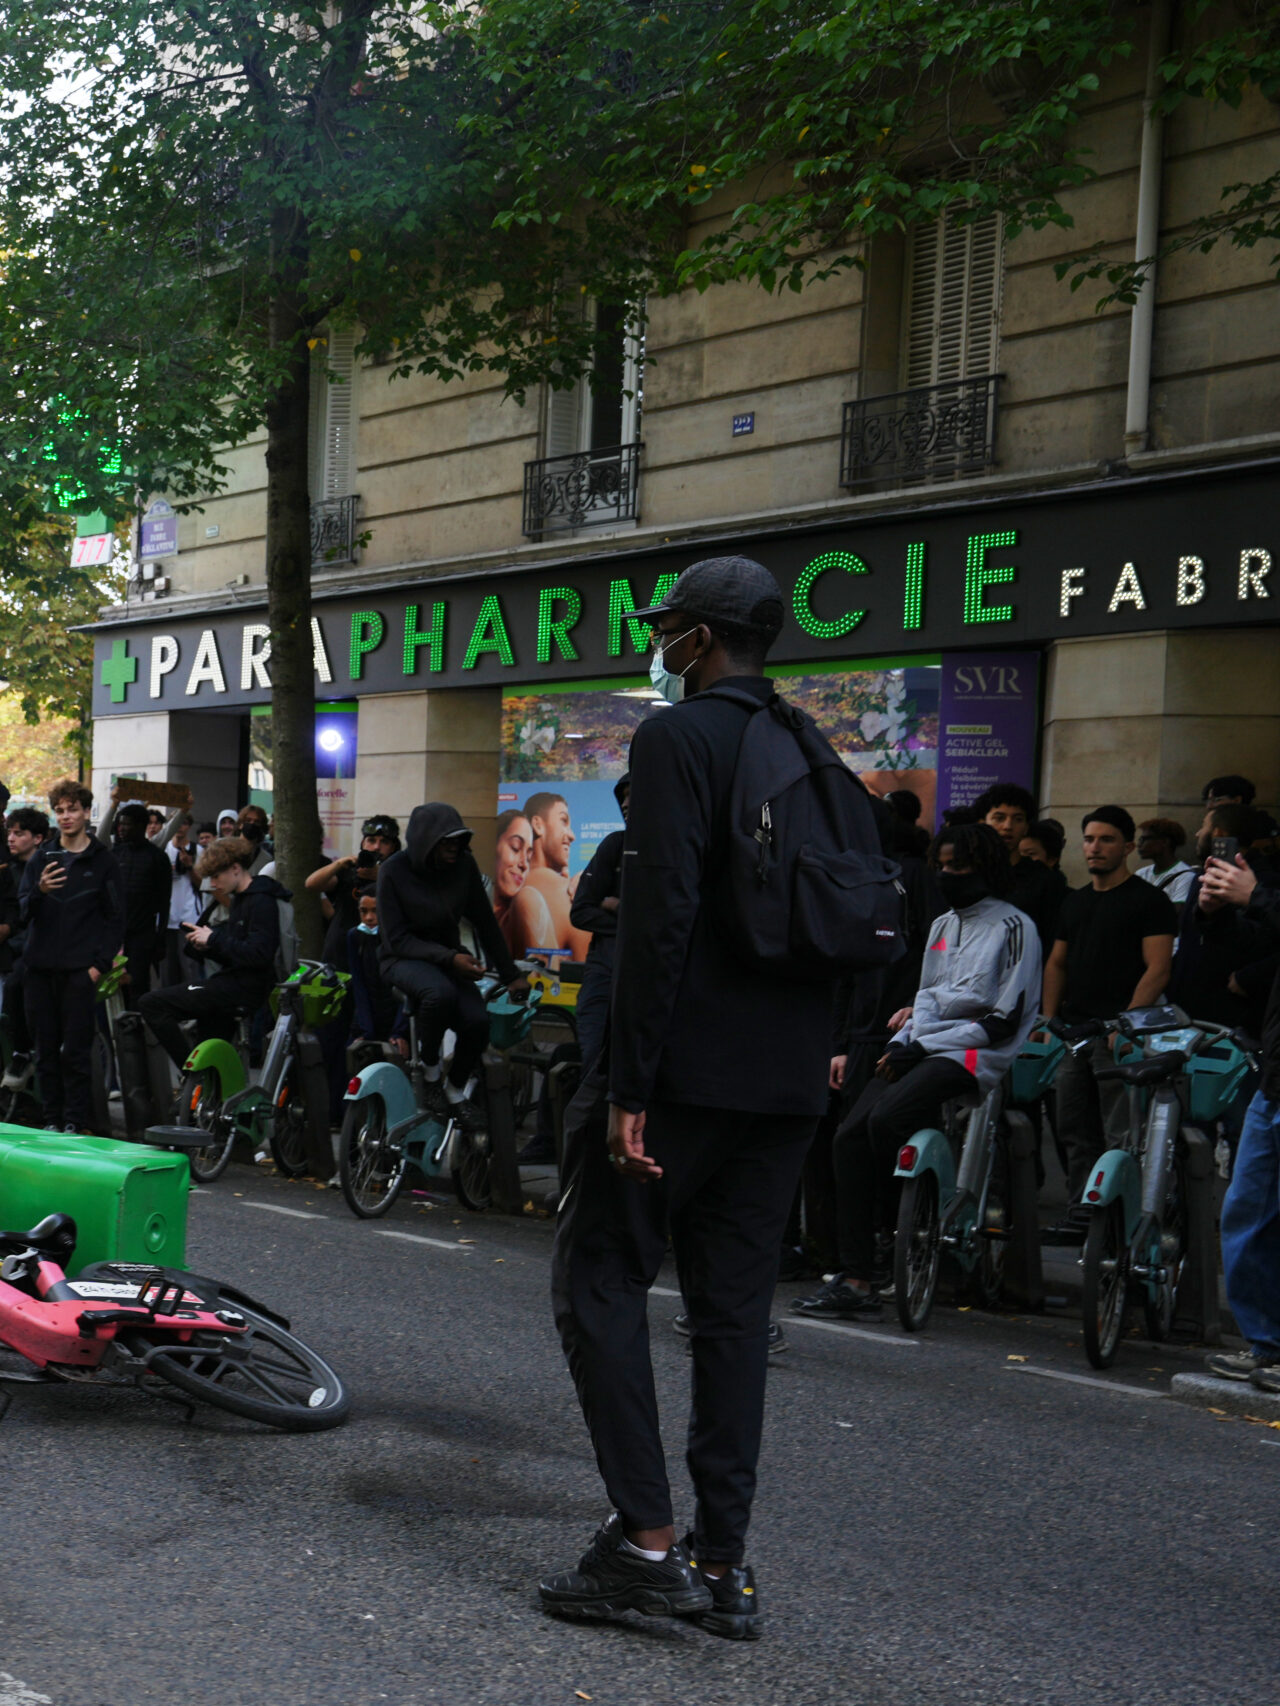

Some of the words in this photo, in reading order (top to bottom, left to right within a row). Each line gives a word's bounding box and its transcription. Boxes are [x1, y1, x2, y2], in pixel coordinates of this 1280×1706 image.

[734, 416, 751, 433] 22
[76, 535, 107, 563] 7/7
[1058, 547, 1273, 618] FABR
[954, 665, 1022, 694] SVR
[945, 738, 983, 748] ACTIVE
[984, 738, 1005, 748] GEL
[945, 748, 1009, 757] SEBIACLEAR
[951, 774, 999, 783] visiblement
